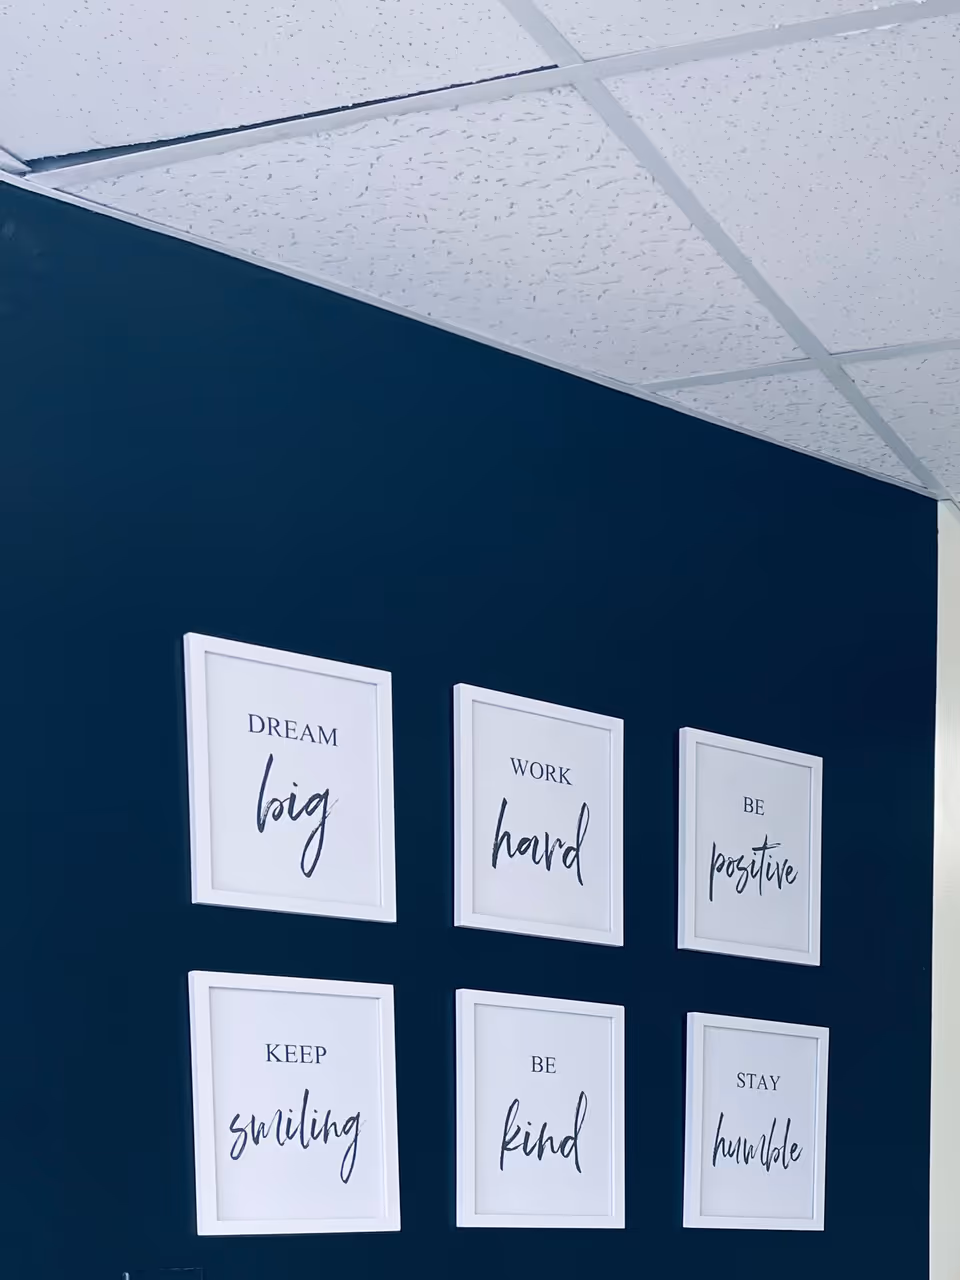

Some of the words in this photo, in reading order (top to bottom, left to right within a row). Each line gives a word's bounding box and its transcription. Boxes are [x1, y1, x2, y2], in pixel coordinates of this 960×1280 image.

[247, 713, 338, 748] DREAM
[510, 756, 573, 786] WORK
[256, 753, 339, 879] big
[743, 796, 765, 816] BE
[491, 797, 590, 886] hard
[708, 834, 799, 902] positive
[265, 1043, 328, 1067] KEEP
[531, 1055, 557, 1075] BE
[736, 1071, 781, 1091] STAY
[229, 1088, 364, 1184] smiling
[499, 1091, 588, 1174] kind
[712, 1112, 804, 1173] humble
